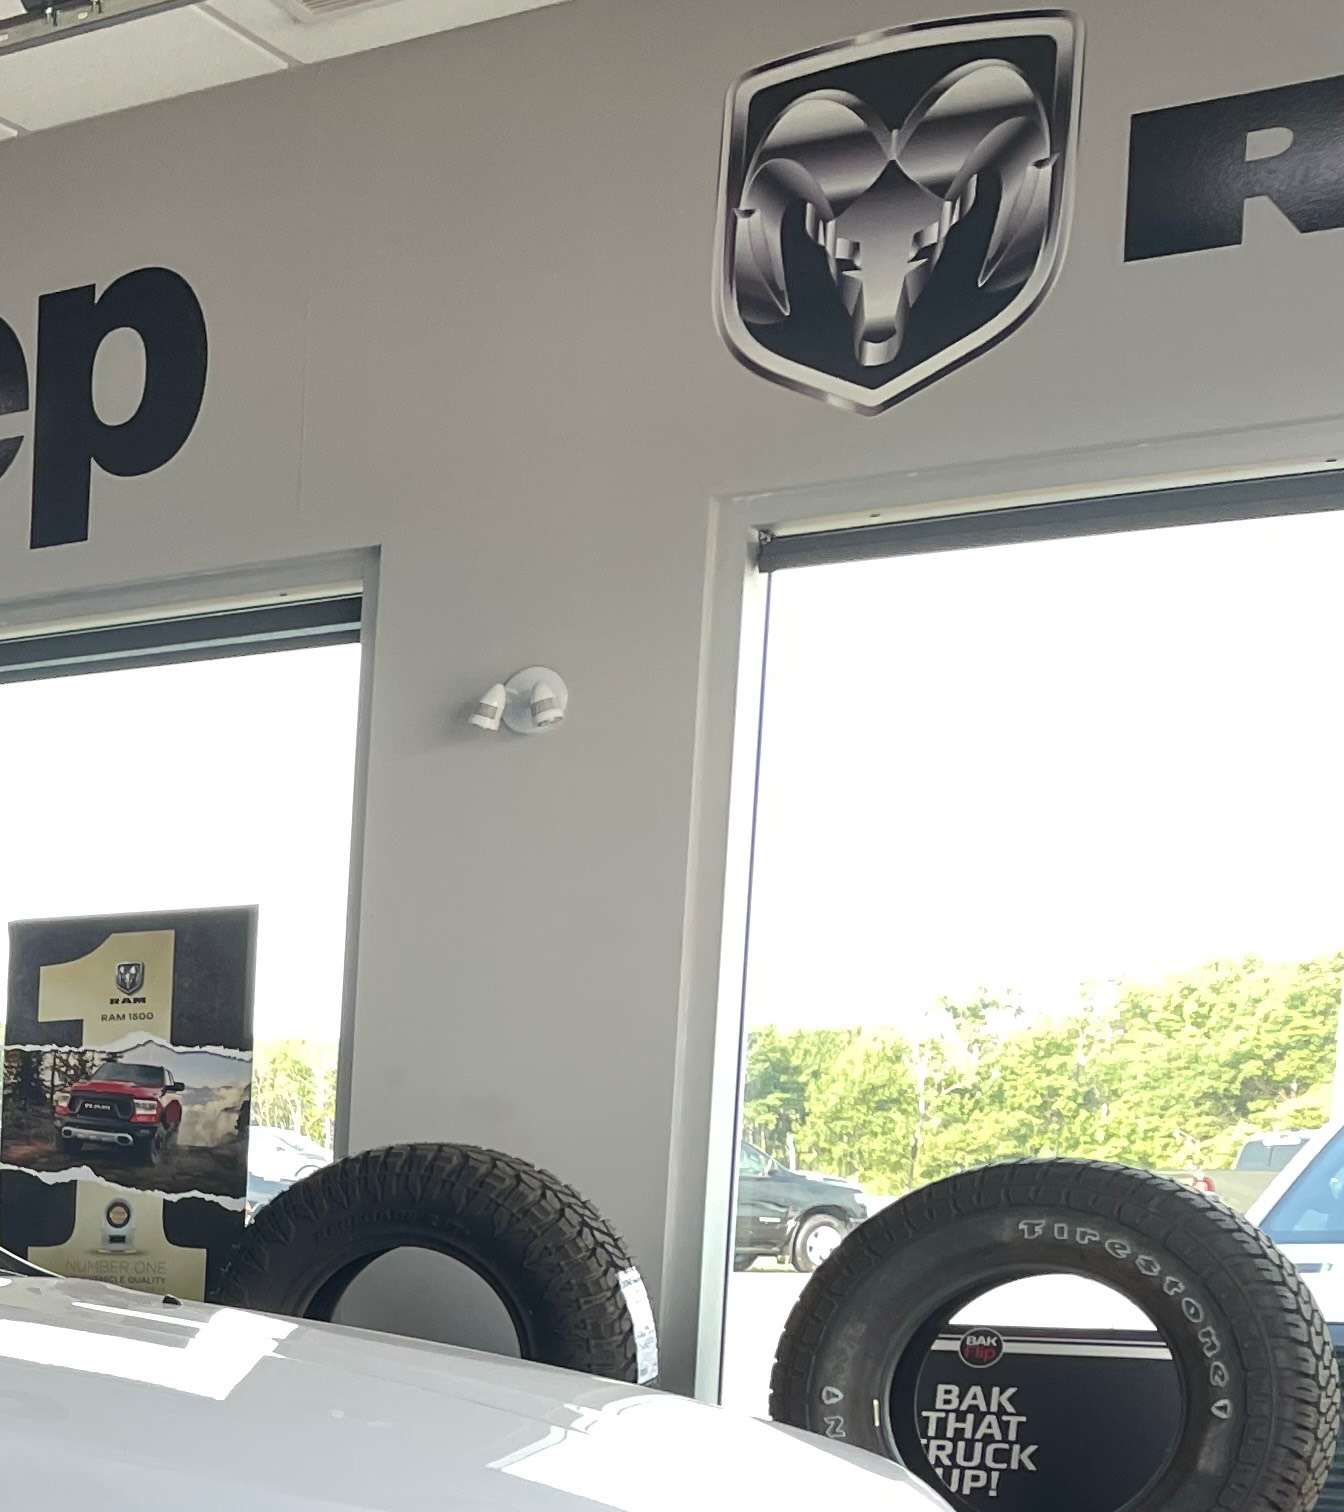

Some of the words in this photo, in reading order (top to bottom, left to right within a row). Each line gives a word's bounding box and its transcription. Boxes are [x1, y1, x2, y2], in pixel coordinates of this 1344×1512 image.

[109, 996, 147, 1005] RAM
[101, 1013, 126, 1023] RAM
[66, 1258, 129, 1275] NUMBER
[134, 1260, 168, 1275] ONE
[1018, 1219, 1230, 1389] Firestone
[966, 1335, 998, 1347] BAK
[935, 1383, 1018, 1414] BAK
[921, 1411, 1027, 1441] THAT
[920, 1439, 1039, 1471] RUCK
